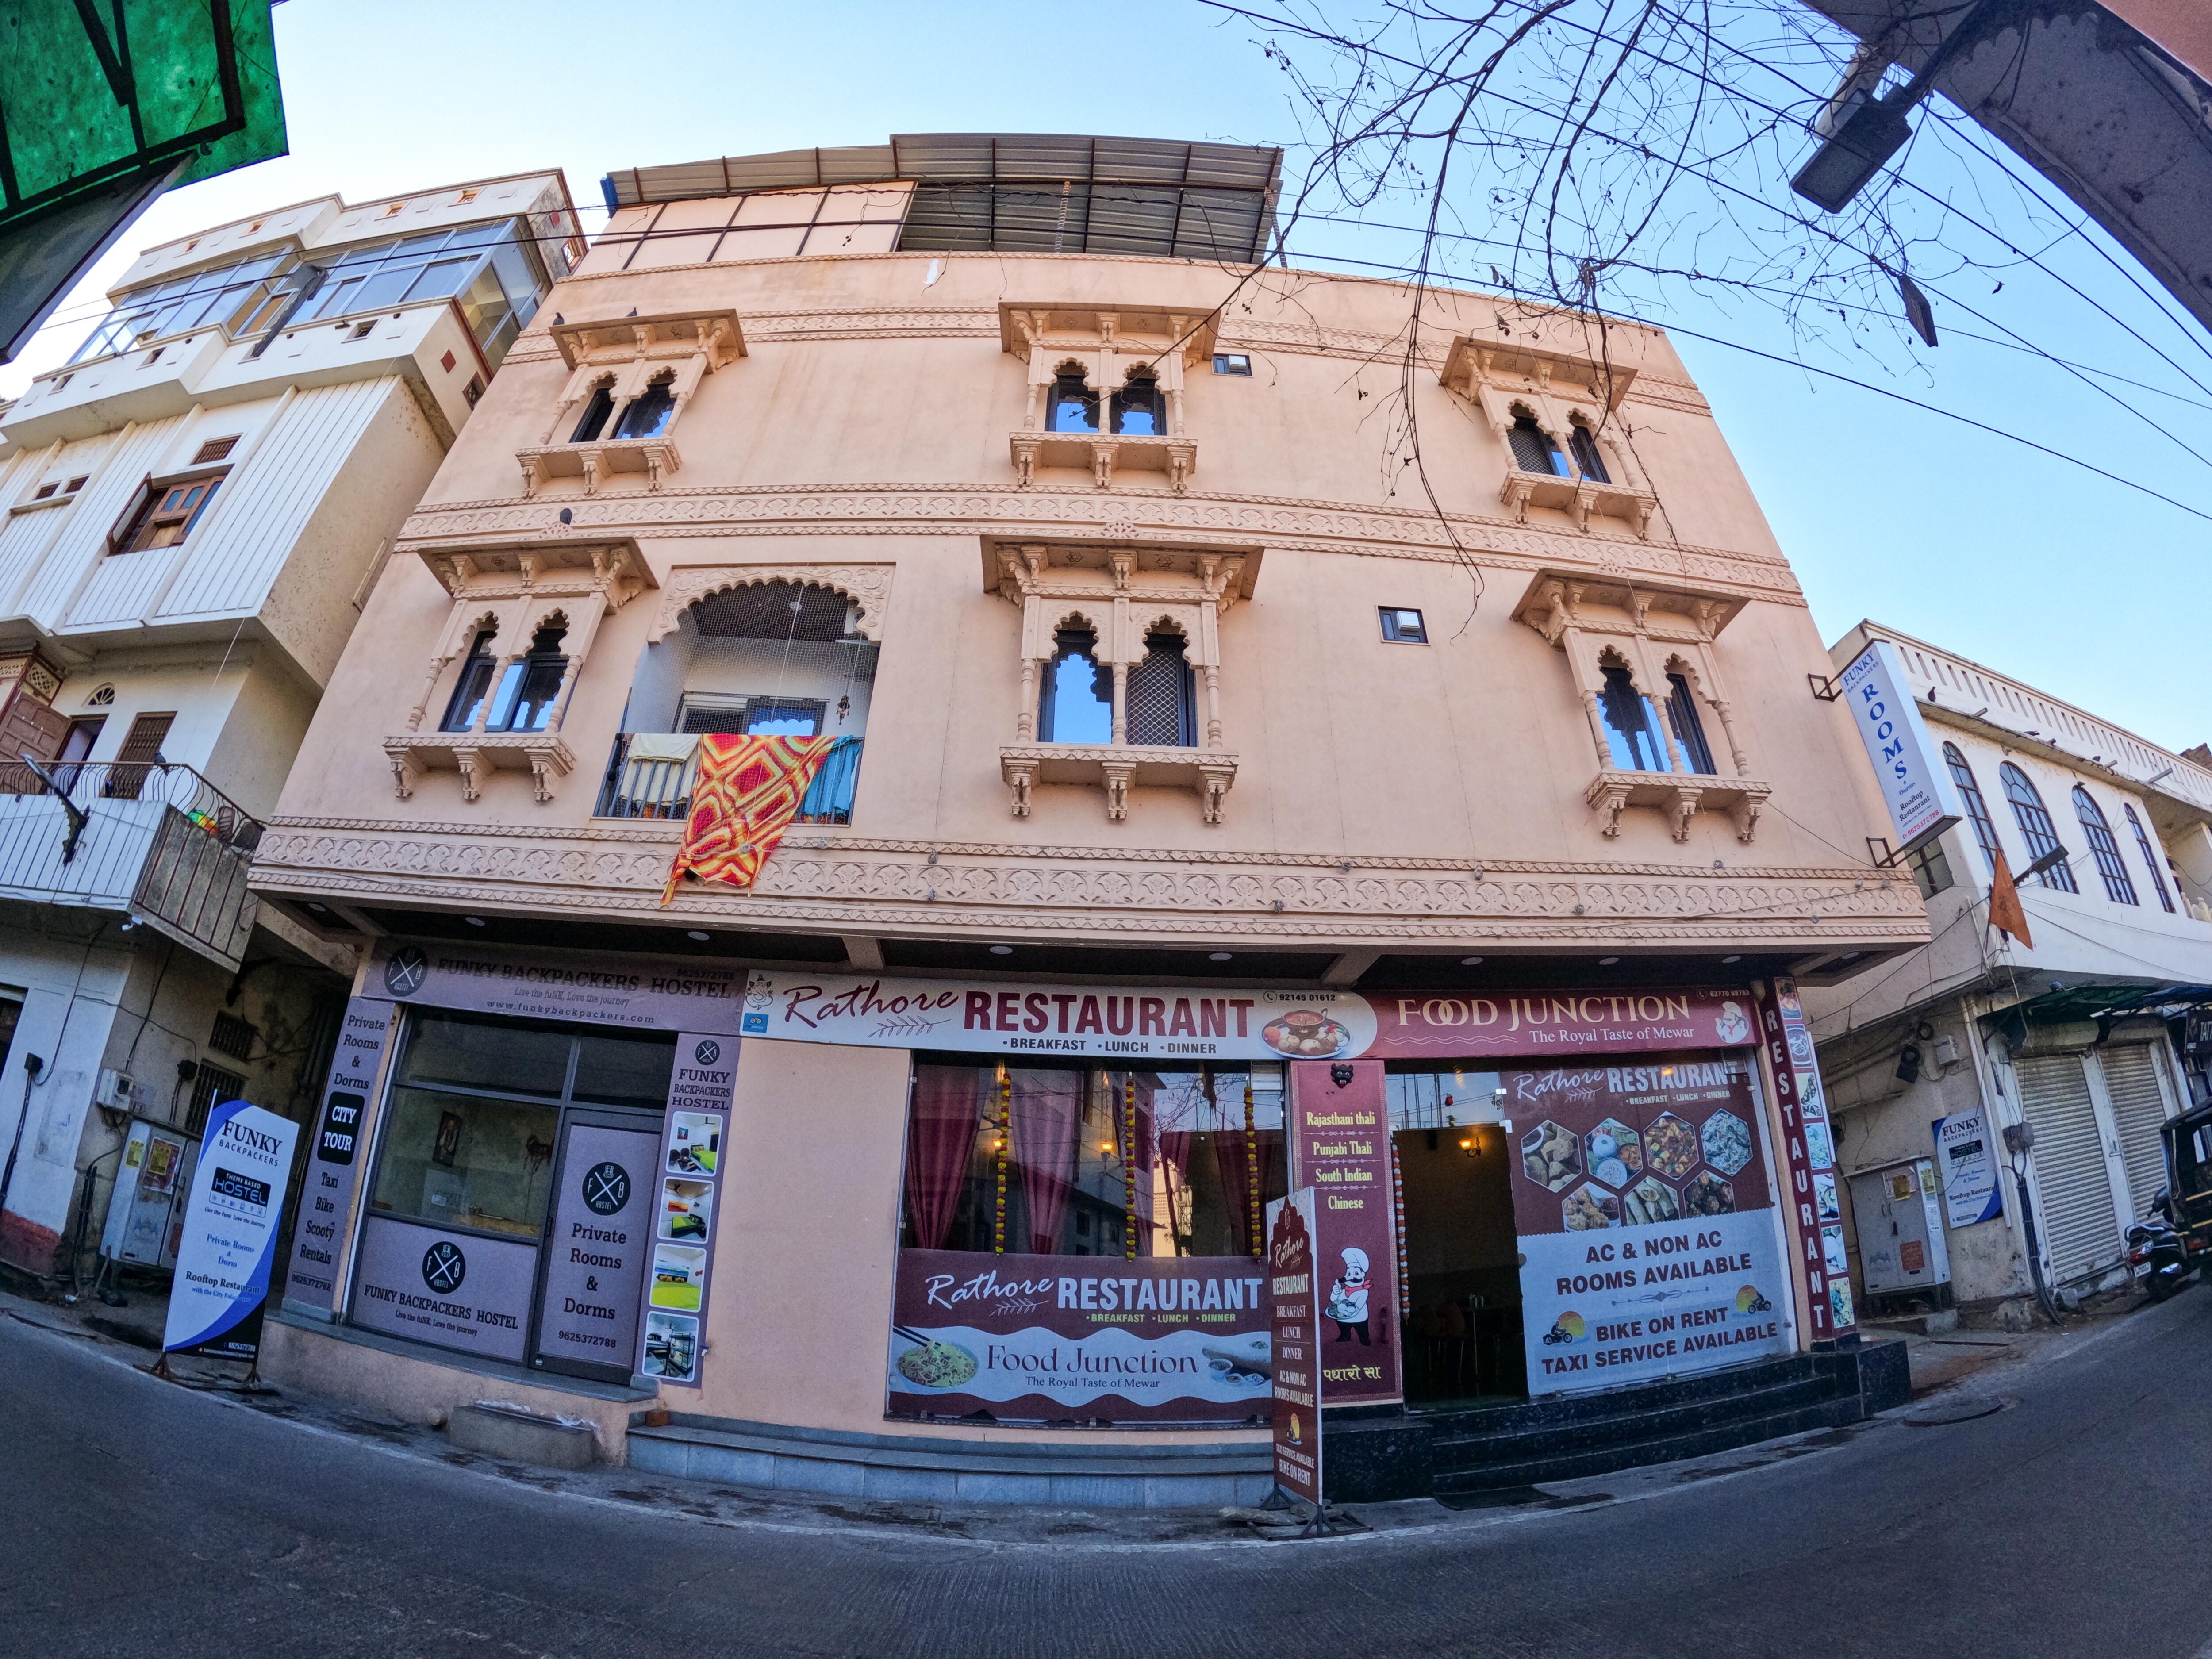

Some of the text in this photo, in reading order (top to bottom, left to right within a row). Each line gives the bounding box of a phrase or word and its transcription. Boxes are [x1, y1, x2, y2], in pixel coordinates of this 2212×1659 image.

[1843, 650, 1874, 687] FUNKY
[1847, 661, 1879, 693] BACKPACKERS
[1861, 684, 1907, 779] ROOMS
[1899, 795, 1930, 822] Restaurant
[1900, 791, 1923, 811] Rooftop
[1907, 810, 1939, 836] 9625372788
[438, 957, 732, 999] FUNKY BACKPACKERS HOSTEL
[783, 979, 1255, 1038] Rathore RESTAURANT
[1397, 995, 1691, 1032] FOOD JUNCTION
[347, 1014, 385, 1031] Private
[343, 1034, 379, 1050] Rooms
[1010, 1038, 1217, 1054] BREAKFAST LUNCH DINNER
[1529, 1026, 1694, 1045] The Royal Taste of Mewar
[351, 1055, 361, 1068] &
[333, 1073, 369, 1089] Dorms
[678, 1068, 730, 1083] FUNKY
[1513, 1061, 1738, 1102] Rathore RESTAURANT
[673, 1083, 731, 1098] BACKPACKERS
[1629, 1090, 1731, 1105] BREAKFAST LUNCH DINNER
[671, 1096, 729, 1110] HOSTEL
[331, 1105, 357, 1124] CITY
[1306, 1110, 1375, 1128] Rajasthani thali
[221, 1119, 283, 1155] FUNKY
[1942, 1116, 1981, 1137] FUNKY
[323, 1131, 352, 1152] TOUR
[1313, 1141, 1372, 1157] Punjabi Thali
[219, 1139, 279, 1167] BACKPACKERS
[1316, 1167, 1373, 1183] South Indian
[1766, 1010, 1824, 1329] RESTAURANT
[215, 1177, 266, 1204] HOSTEL
[226, 1173, 261, 1189] THEME BASED
[321, 1172, 339, 1189] Taxi
[618, 1181, 625, 1199] B
[315, 1196, 334, 1214] Bike
[595, 1201, 612, 1210] HOSTEL
[1328, 1195, 1363, 1210] Chinese
[306, 1220, 335, 1241] Scooty
[571, 1222, 627, 1244] Private
[207, 1233, 255, 1252] Private Rooms
[1275, 1235, 1304, 1269] Rathore
[1586, 1230, 1723, 1264] AC & NON AC
[218, 1256, 238, 1268] Dorm
[299, 1243, 332, 1265] Rentals
[569, 1248, 622, 1270] Rooms
[185, 1270, 261, 1294] Rooftop Restaurant
[586, 1275, 599, 1292] &
[1272, 1273, 1309, 1295] RESTAURANT
[1556, 1253, 1753, 1295] ROOMS AVAILABLE
[925, 1269, 1263, 1310] Rathore RESTAURANT
[363, 1284, 519, 1329] FUNKY BACKPACKERS HOSTEL
[563, 1297, 616, 1320] Dorms
[1277, 1305, 1306, 1317] BREAKFAST
[1091, 1313, 1237, 1323] BREAKFAST LUNCH DINNER
[1596, 1307, 1728, 1342] BIKE ON RENT
[557, 1330, 617, 1348] 9625372788
[1283, 1326, 1301, 1339] LUNCH
[1283, 1347, 1302, 1361] DINNER
[1541, 1322, 1778, 1375] TAXI SERVICE AVAILABLE
[987, 1345, 1199, 1375] Food Junction
[1025, 1376, 1160, 1390] The Royal Taste of Mewar
[1280, 1370, 1306, 1387] AC & NON AC
[1323, 1365, 1381, 1382] पधारो सा
[1275, 1386, 1314, 1408] ROOMS AVAILABLE
[1283, 1446, 1296, 1460] SERVICE
[1296, 1451, 1315, 1469] AVAILABLE
[1279, 1458, 1311, 1487] BIKE ON RENT
